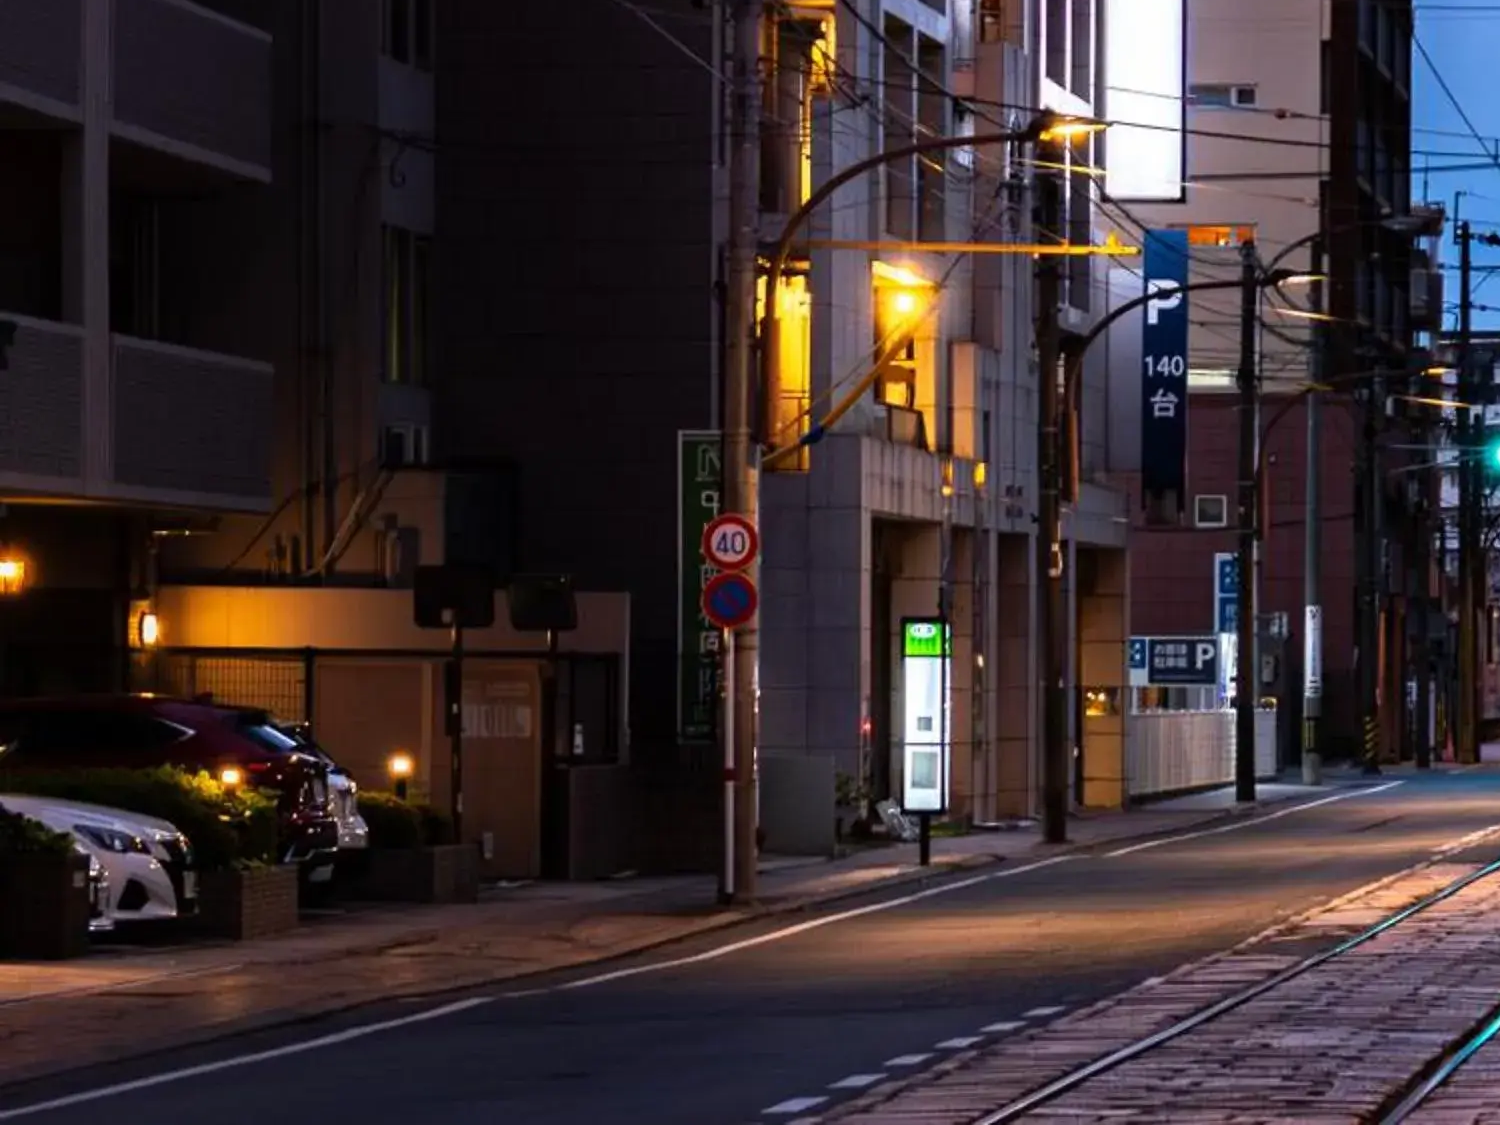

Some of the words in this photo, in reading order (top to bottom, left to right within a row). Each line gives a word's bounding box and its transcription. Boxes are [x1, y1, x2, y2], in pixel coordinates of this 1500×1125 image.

[1147, 279, 1182, 325] P
[1144, 355, 1184, 377] 140
[1150, 388, 1179, 418] 台
[716, 532, 745, 555] 40
[1195, 642, 1215, 670] P
